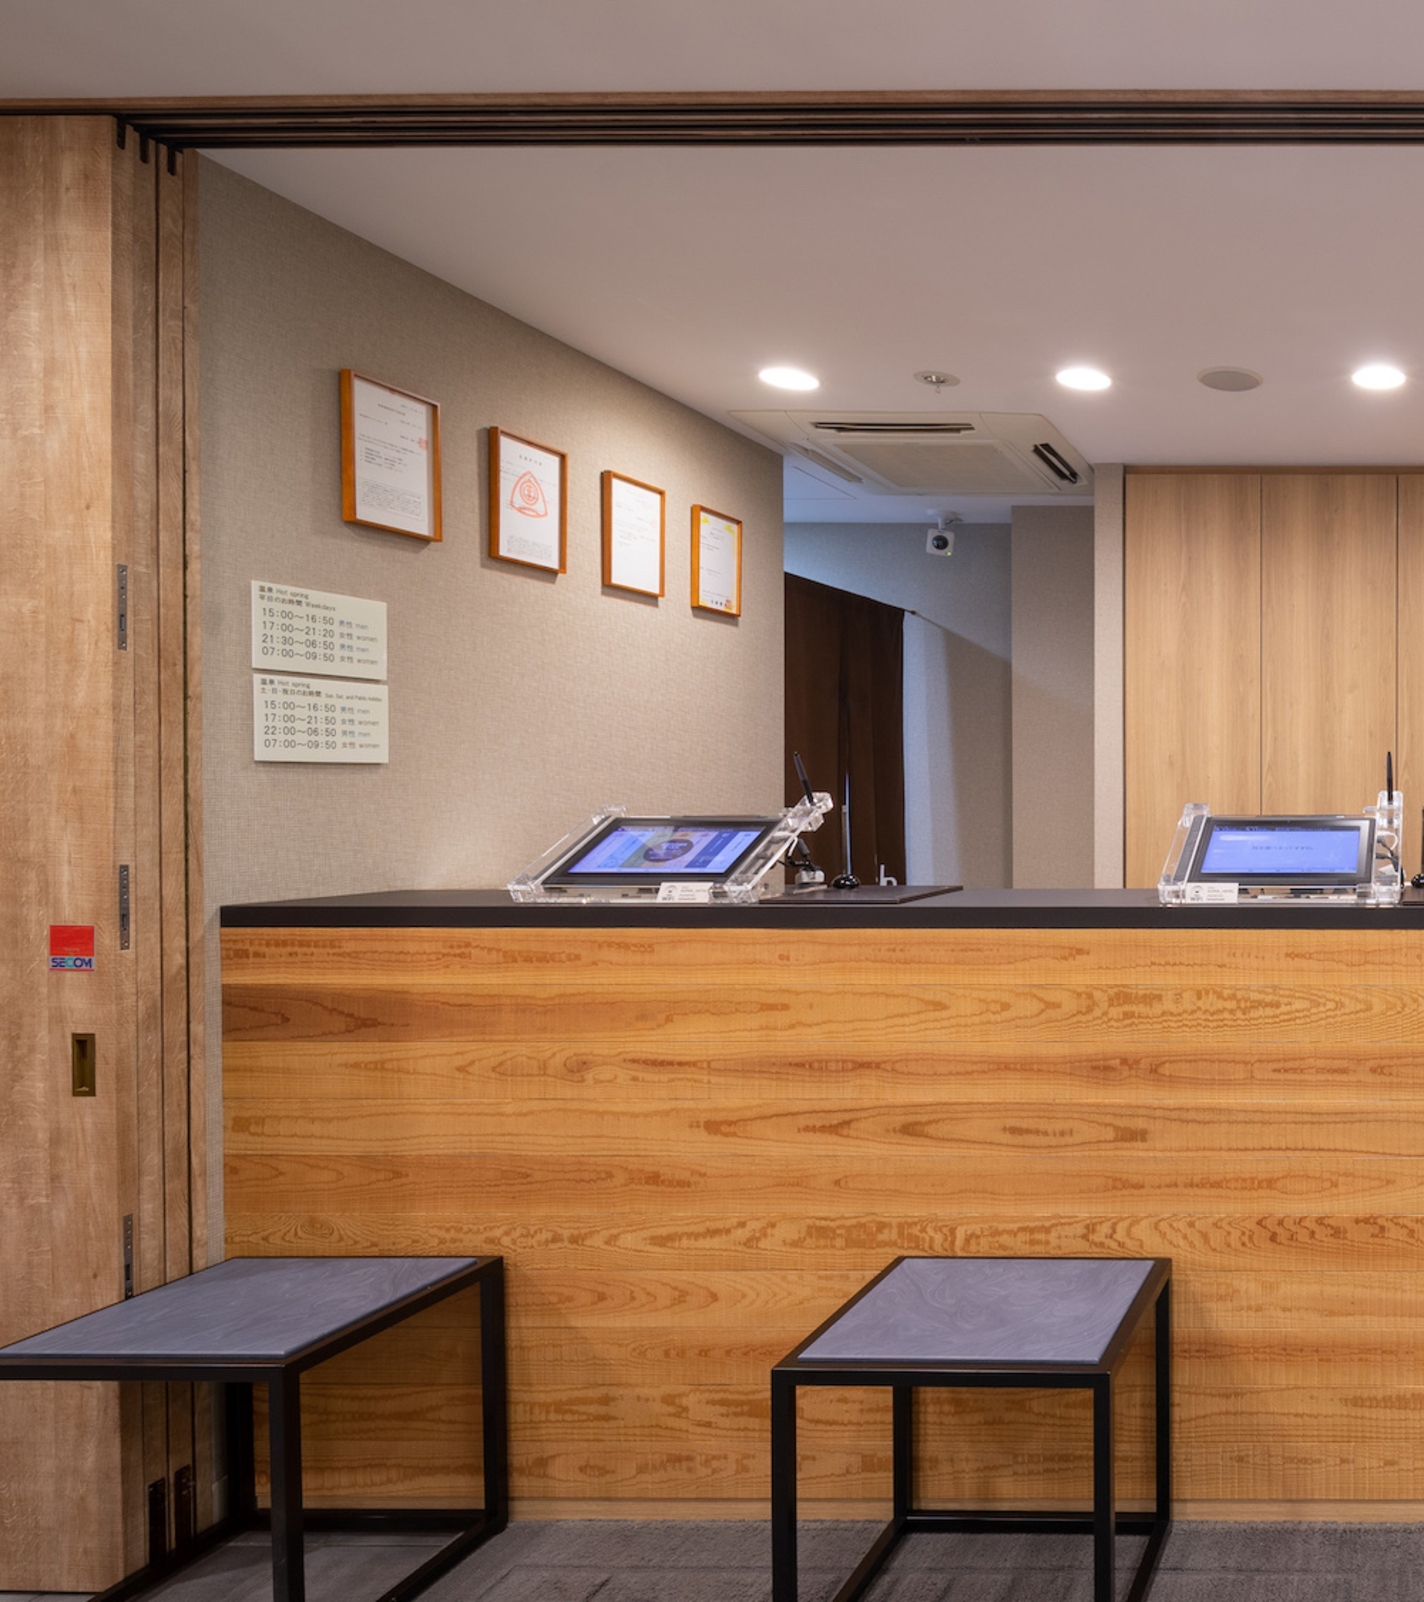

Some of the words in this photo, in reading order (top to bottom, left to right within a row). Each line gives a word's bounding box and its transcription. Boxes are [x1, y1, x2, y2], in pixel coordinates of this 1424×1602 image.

[276, 588, 288, 597] Hot
[290, 590, 310, 600] spring
[51, 957, 92, 968] SECOM
